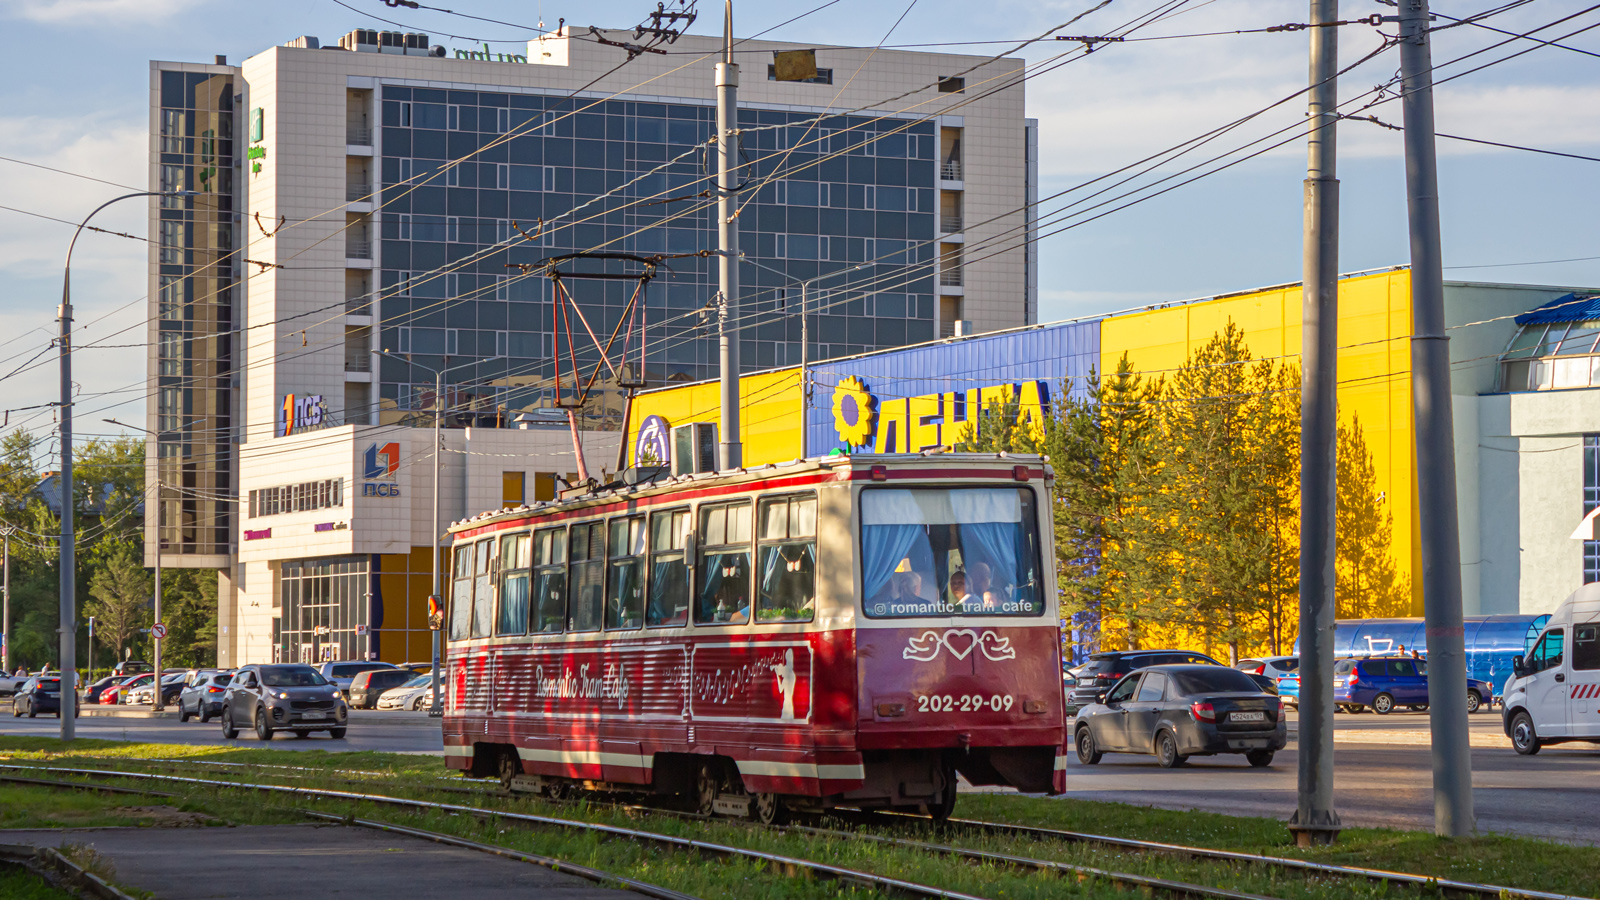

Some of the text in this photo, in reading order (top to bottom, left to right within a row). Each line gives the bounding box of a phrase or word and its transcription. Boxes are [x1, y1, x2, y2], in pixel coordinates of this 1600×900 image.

[295, 395, 323, 427] ПСБ
[364, 483, 400, 496] ПСБ
[891, 599, 1033, 615] romantic_tram_cafe
[536, 662, 629, 710] Romantic Tram Cafe
[918, 694, 1013, 712] 202-29-09
